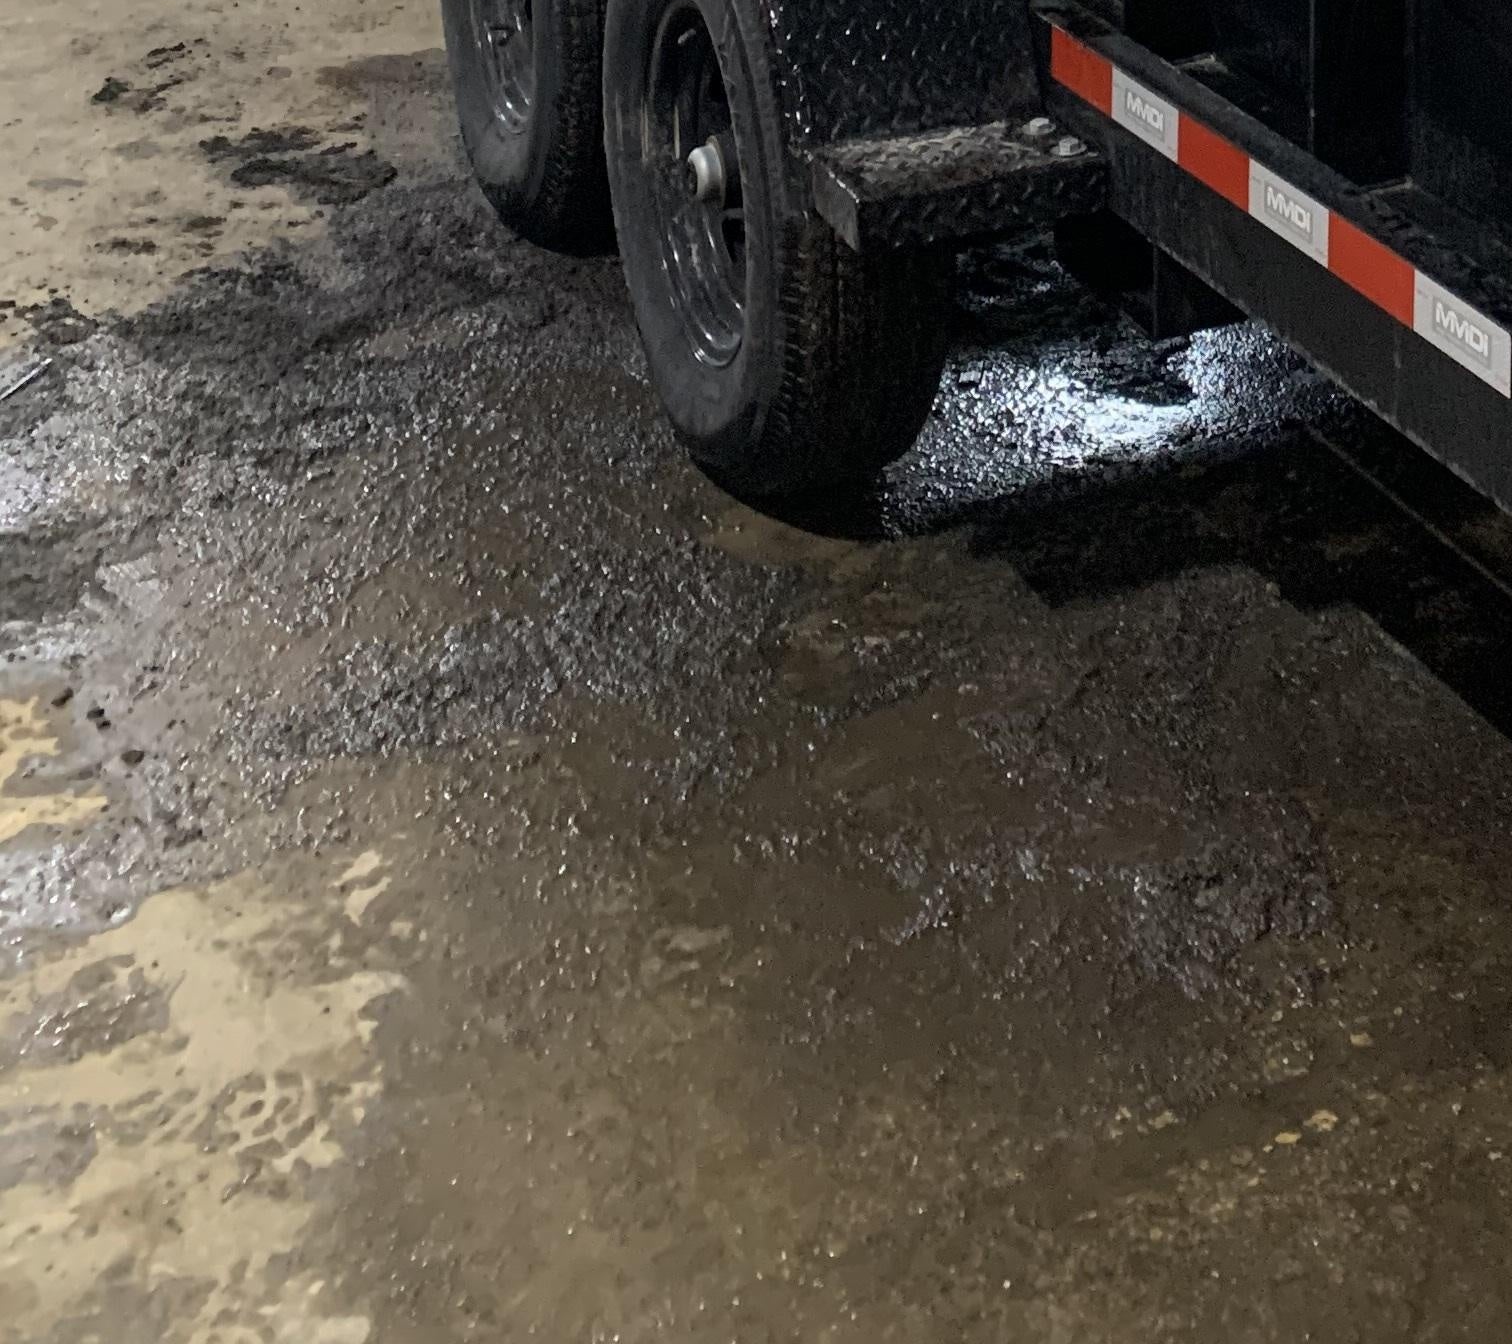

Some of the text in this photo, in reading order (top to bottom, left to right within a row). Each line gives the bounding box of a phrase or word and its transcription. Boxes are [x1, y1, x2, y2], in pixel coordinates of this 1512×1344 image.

[1126, 92, 1164, 131] MMDI
[1266, 186, 1311, 233] MMDI
[1435, 302, 1489, 357] MMDI
